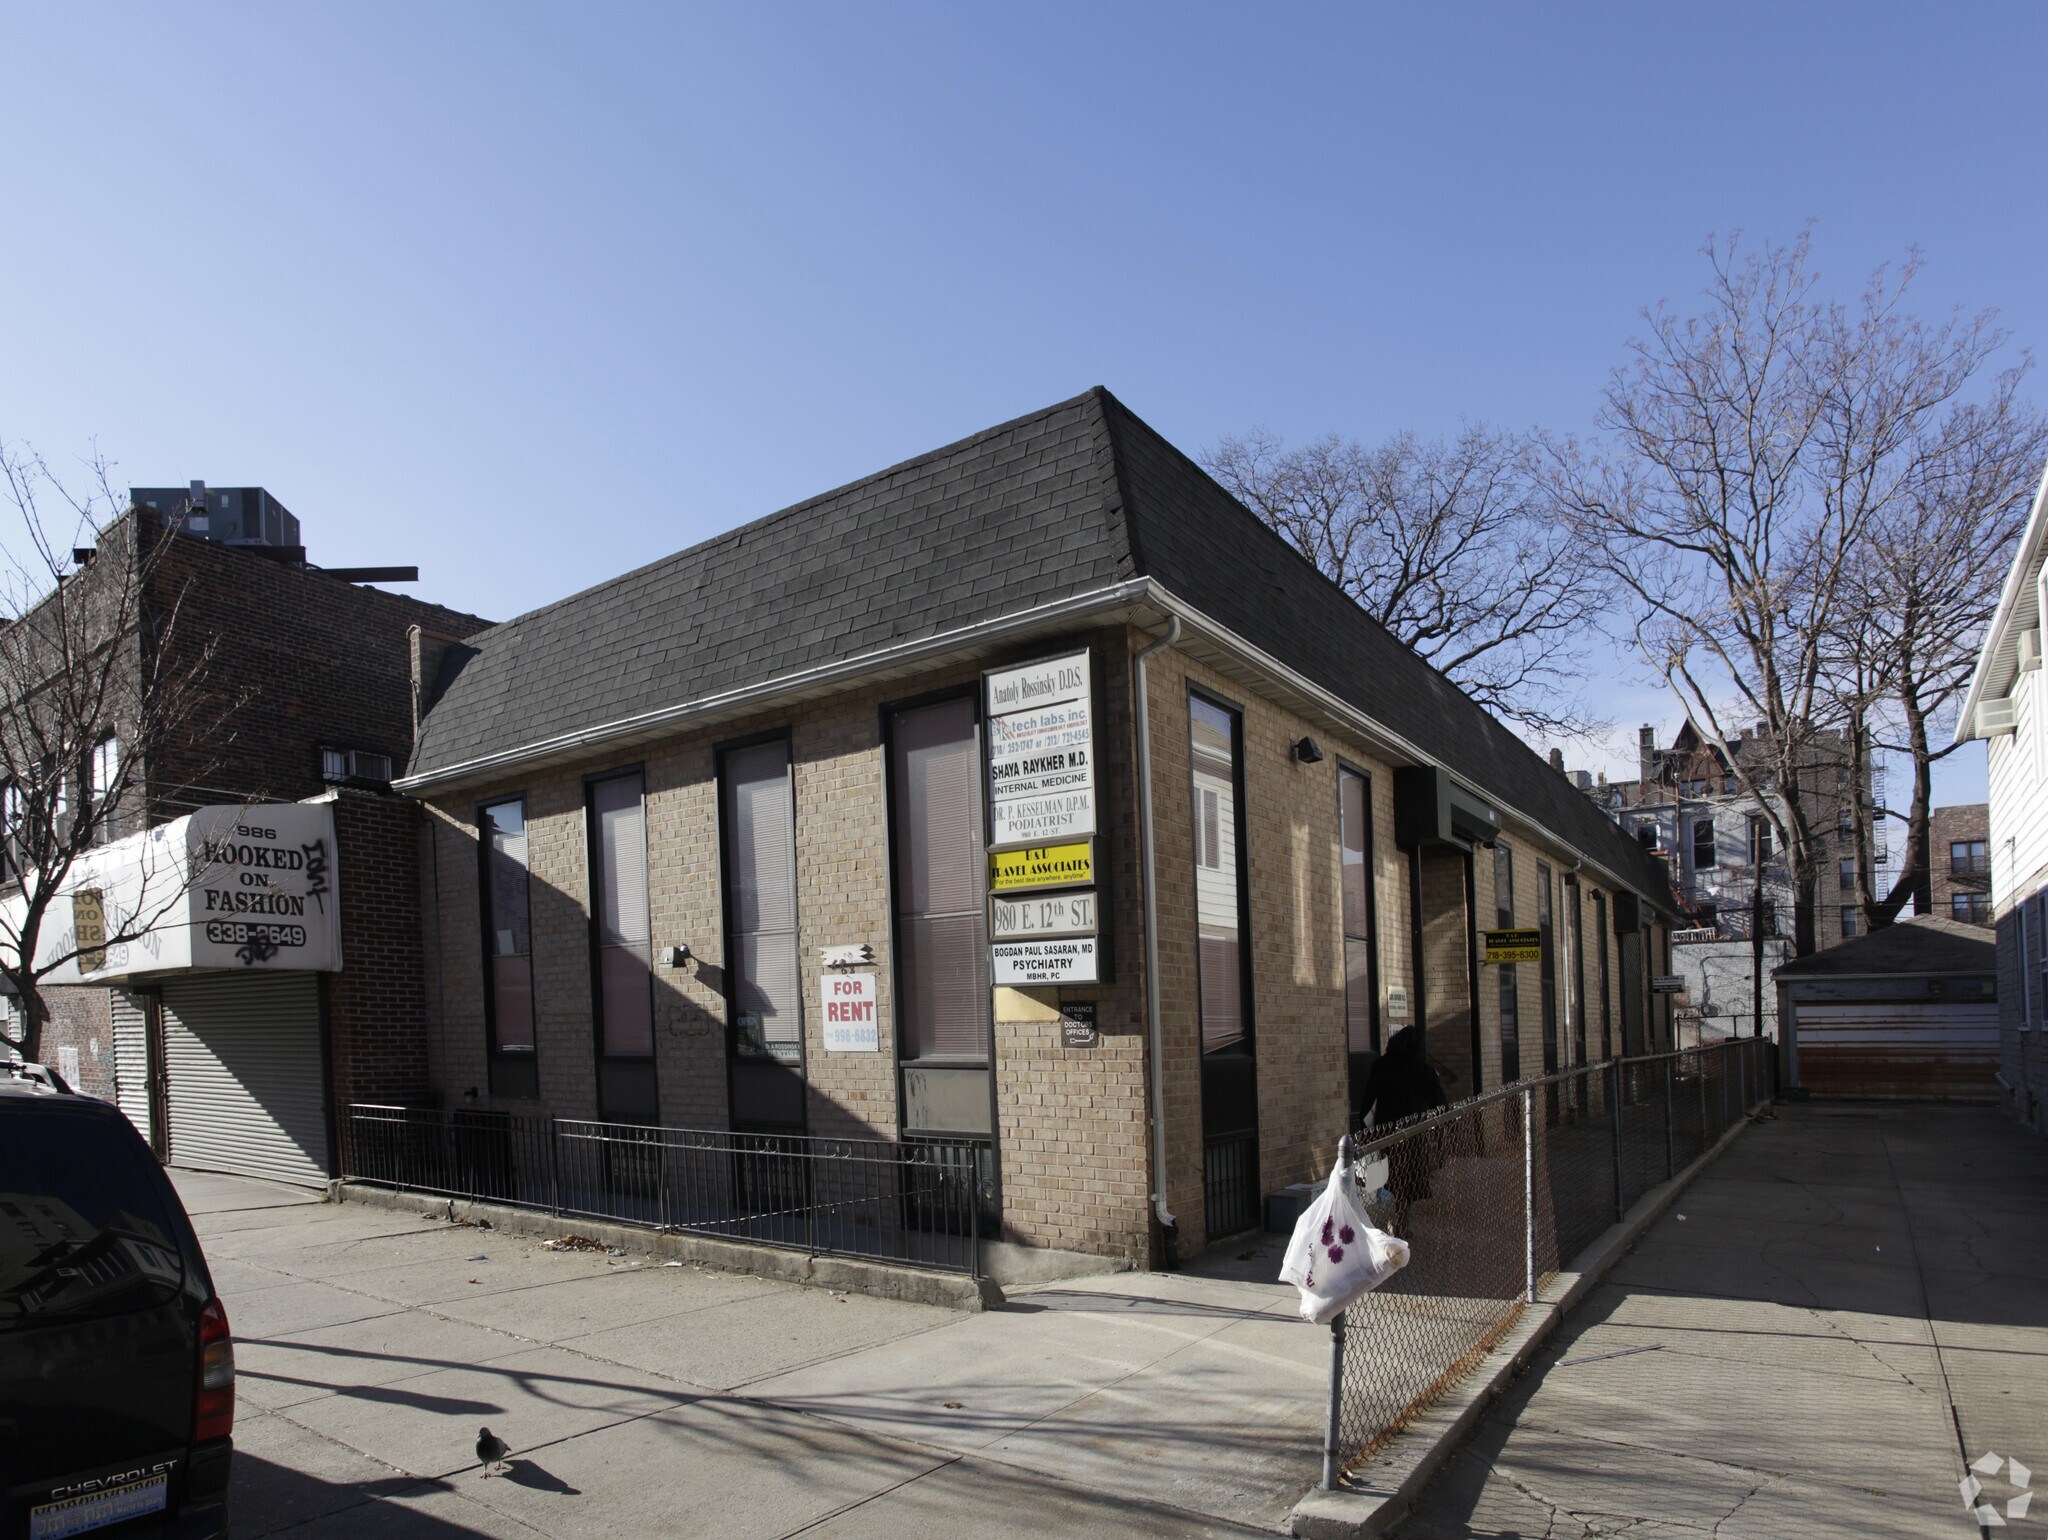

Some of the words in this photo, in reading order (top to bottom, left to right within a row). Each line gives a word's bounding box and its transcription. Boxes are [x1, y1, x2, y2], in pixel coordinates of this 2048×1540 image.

[993, 681, 1019, 705] Anatoly
[1021, 673, 1056, 699] Rossinsky
[1059, 666, 1082, 691] D.D.S.
[992, 762, 1020, 780] SHAYA
[1023, 754, 1065, 775] RAYKHER
[1068, 751, 1088, 768] M.D.
[995, 781, 1038, 795] INTERNAL
[1042, 772, 1087, 788] MEDICINE
[993, 807, 1006, 822] DR.
[1008, 805, 1015, 819] P.
[1017, 798, 1063, 818] KESSELMAN
[1066, 795, 1089, 812] D.P.M.
[1008, 813, 1074, 831] PODIATRIST
[238, 825, 277, 840] 986
[203, 842, 304, 870] HOOKED
[992, 865, 1027, 878] TRAVEL
[1030, 859, 1090, 874] ASSOCIATES
[240, 872, 269, 887] ON
[205, 889, 305, 916] FASHION
[995, 905, 1016, 931] 980
[1021, 903, 1034, 929] E.
[1040, 902, 1064, 928] 12th
[1071, 899, 1093, 926] ST.
[209, 922, 304, 945] 338-2649
[994, 947, 1023, 957] BOGDAN
[1024, 946, 1042, 956] PAUL
[1044, 944, 1080, 956] SASARAN,
[1082, 944, 1093, 953] MD
[1487, 950, 1539, 960] 718-395-8300
[1013, 958, 1073, 970] PSYCHIATRY
[1027, 972, 1049, 981] MBHR,
[834, 981, 862, 995] FOR
[828, 1001, 874, 1022] RENT
[834, 1028, 877, 1043] 998-6832
[1065, 1028, 1090, 1036] OFFICES
[51, 1460, 178, 1500] CHEVROLET
